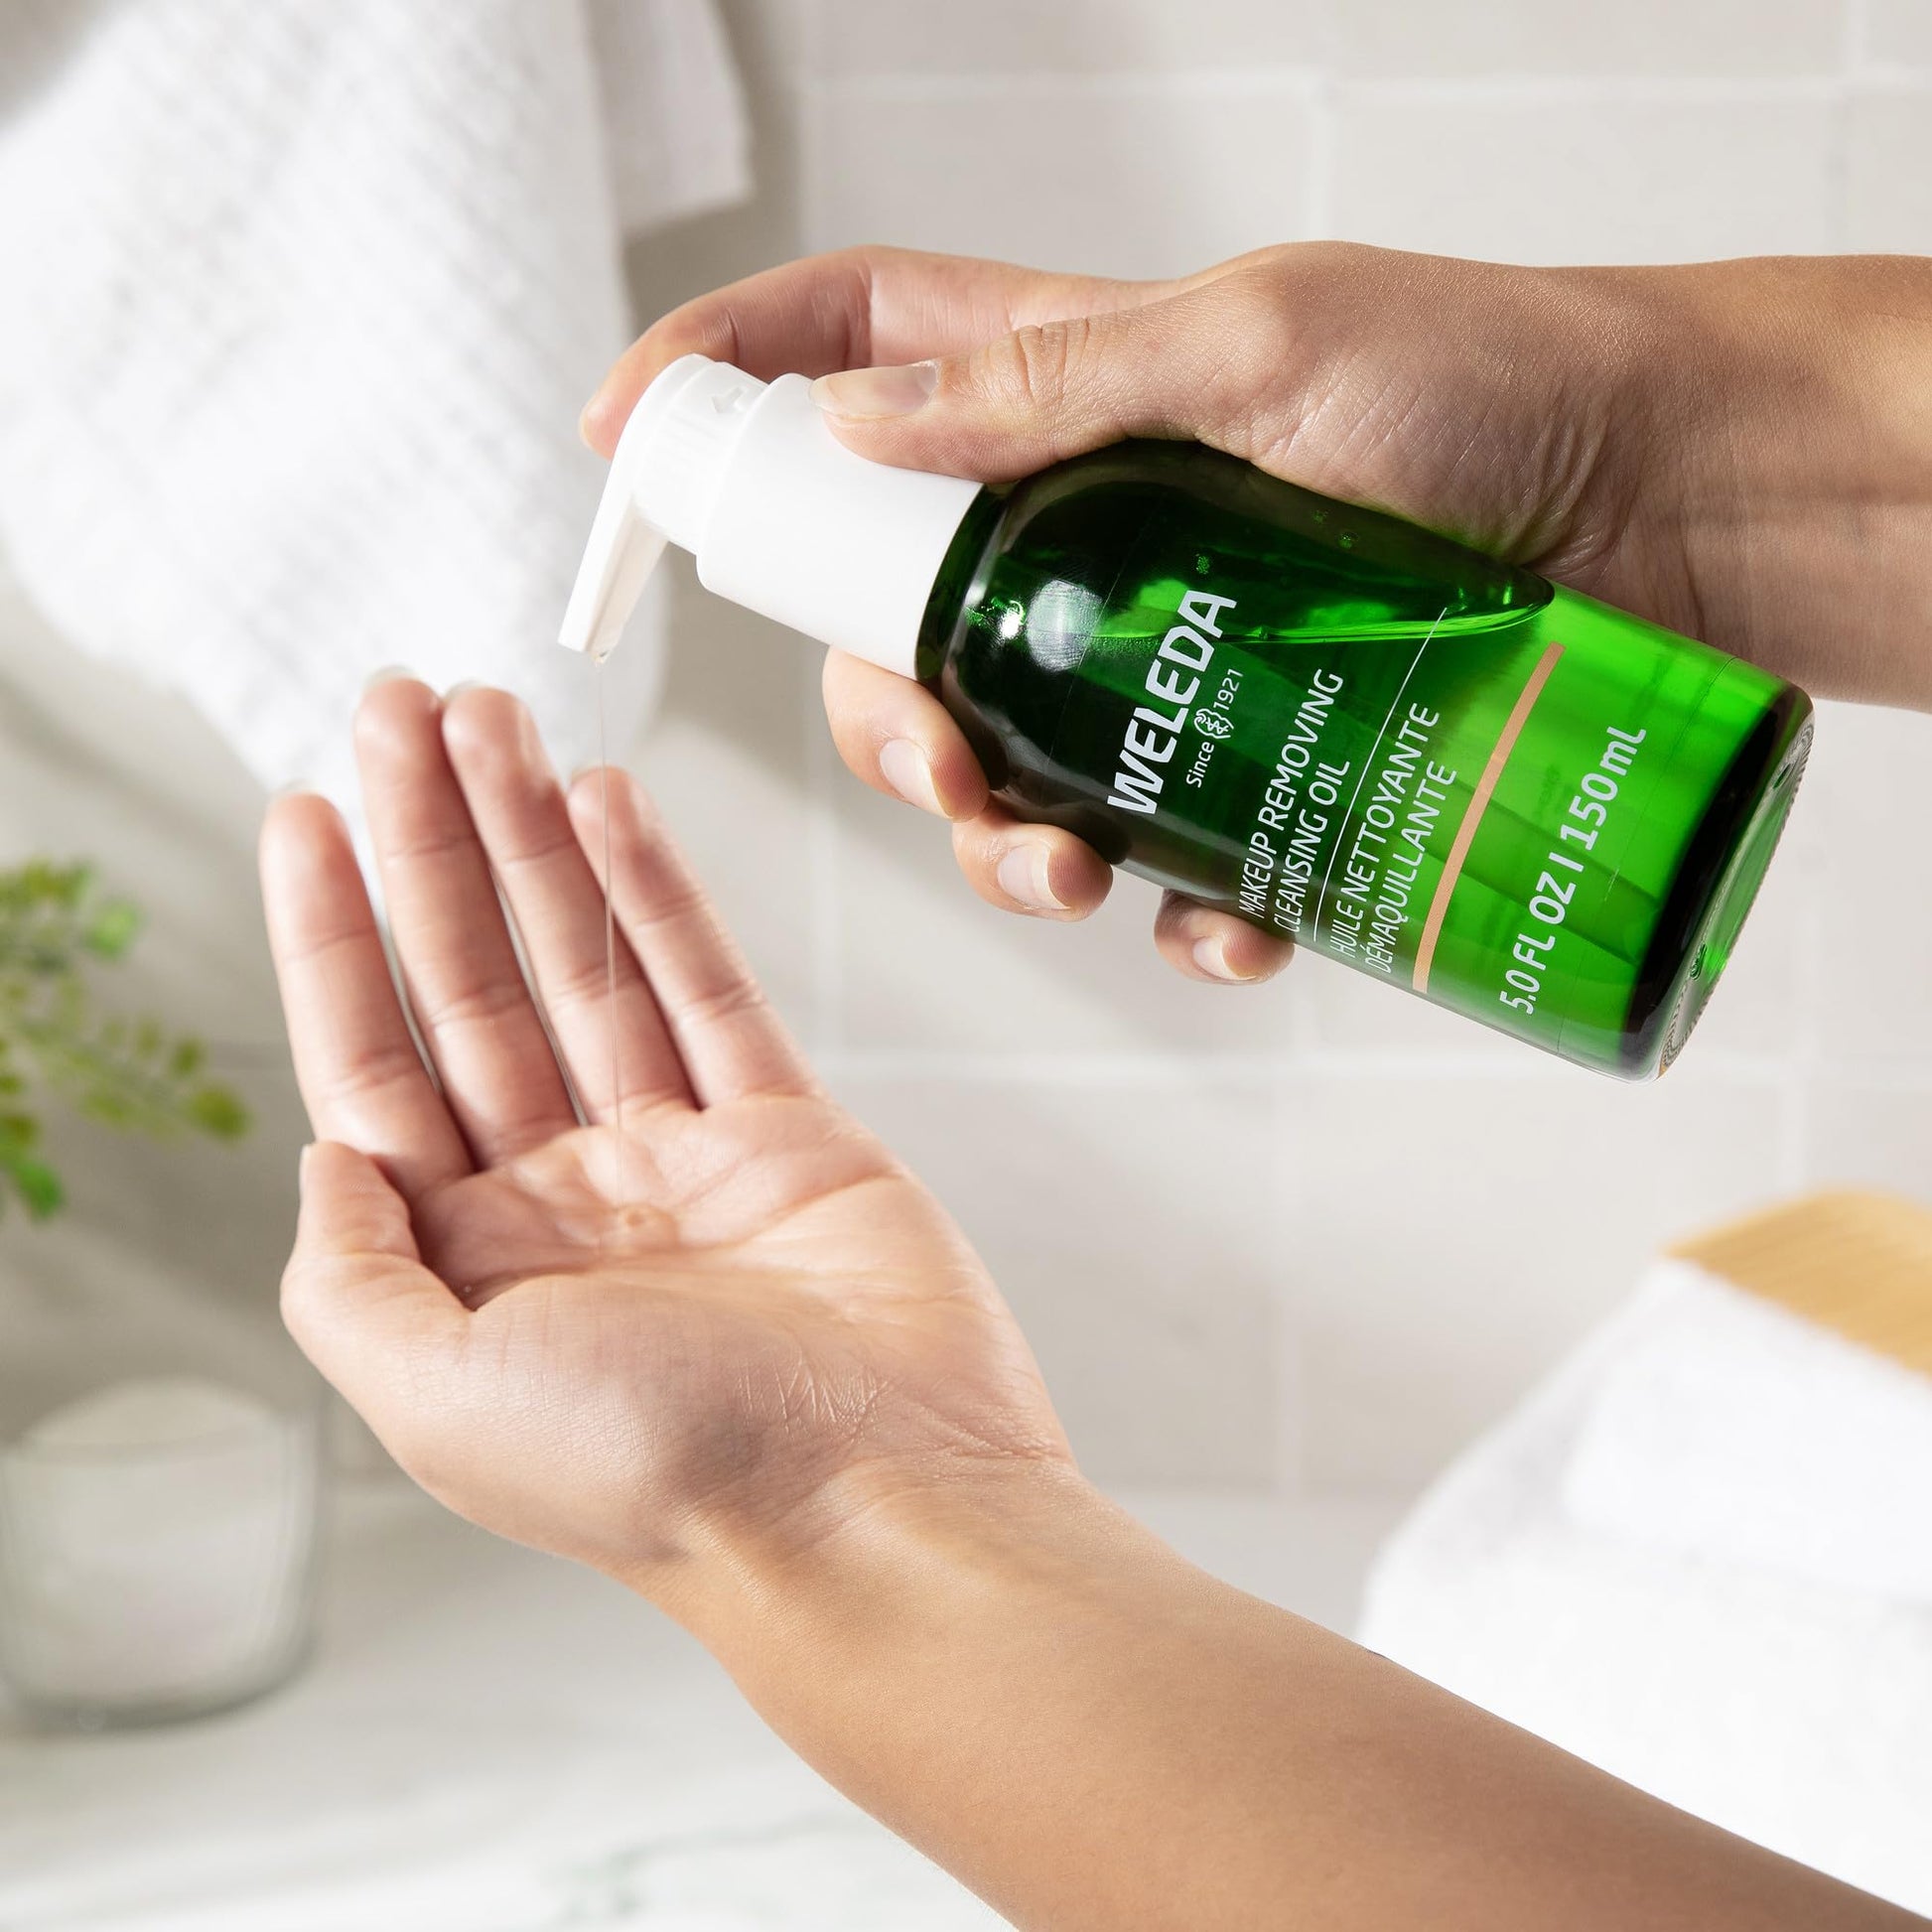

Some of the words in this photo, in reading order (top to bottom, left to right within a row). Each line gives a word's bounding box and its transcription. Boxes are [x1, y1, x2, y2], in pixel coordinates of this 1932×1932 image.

[1107, 590, 1237, 814] WELEDA
[1186, 741, 1214, 787] Since
[1212, 668, 1243, 711] 1921
[1239, 832, 1277, 919] MAKEUP
[1265, 668, 1344, 831] REMOVING
[1274, 809, 1327, 932] CLEANSING
[1318, 760, 1350, 806] OIL
[1341, 703, 1441, 899] NETTOYANTE
[1329, 899, 1363, 958] HUILE
[1365, 760, 1457, 973] DÉMAQUILLANTE
[1529, 872, 1577, 925] OZ
[1499, 969, 1541, 1015] 5.0
[1513, 933, 1556, 971] FL
